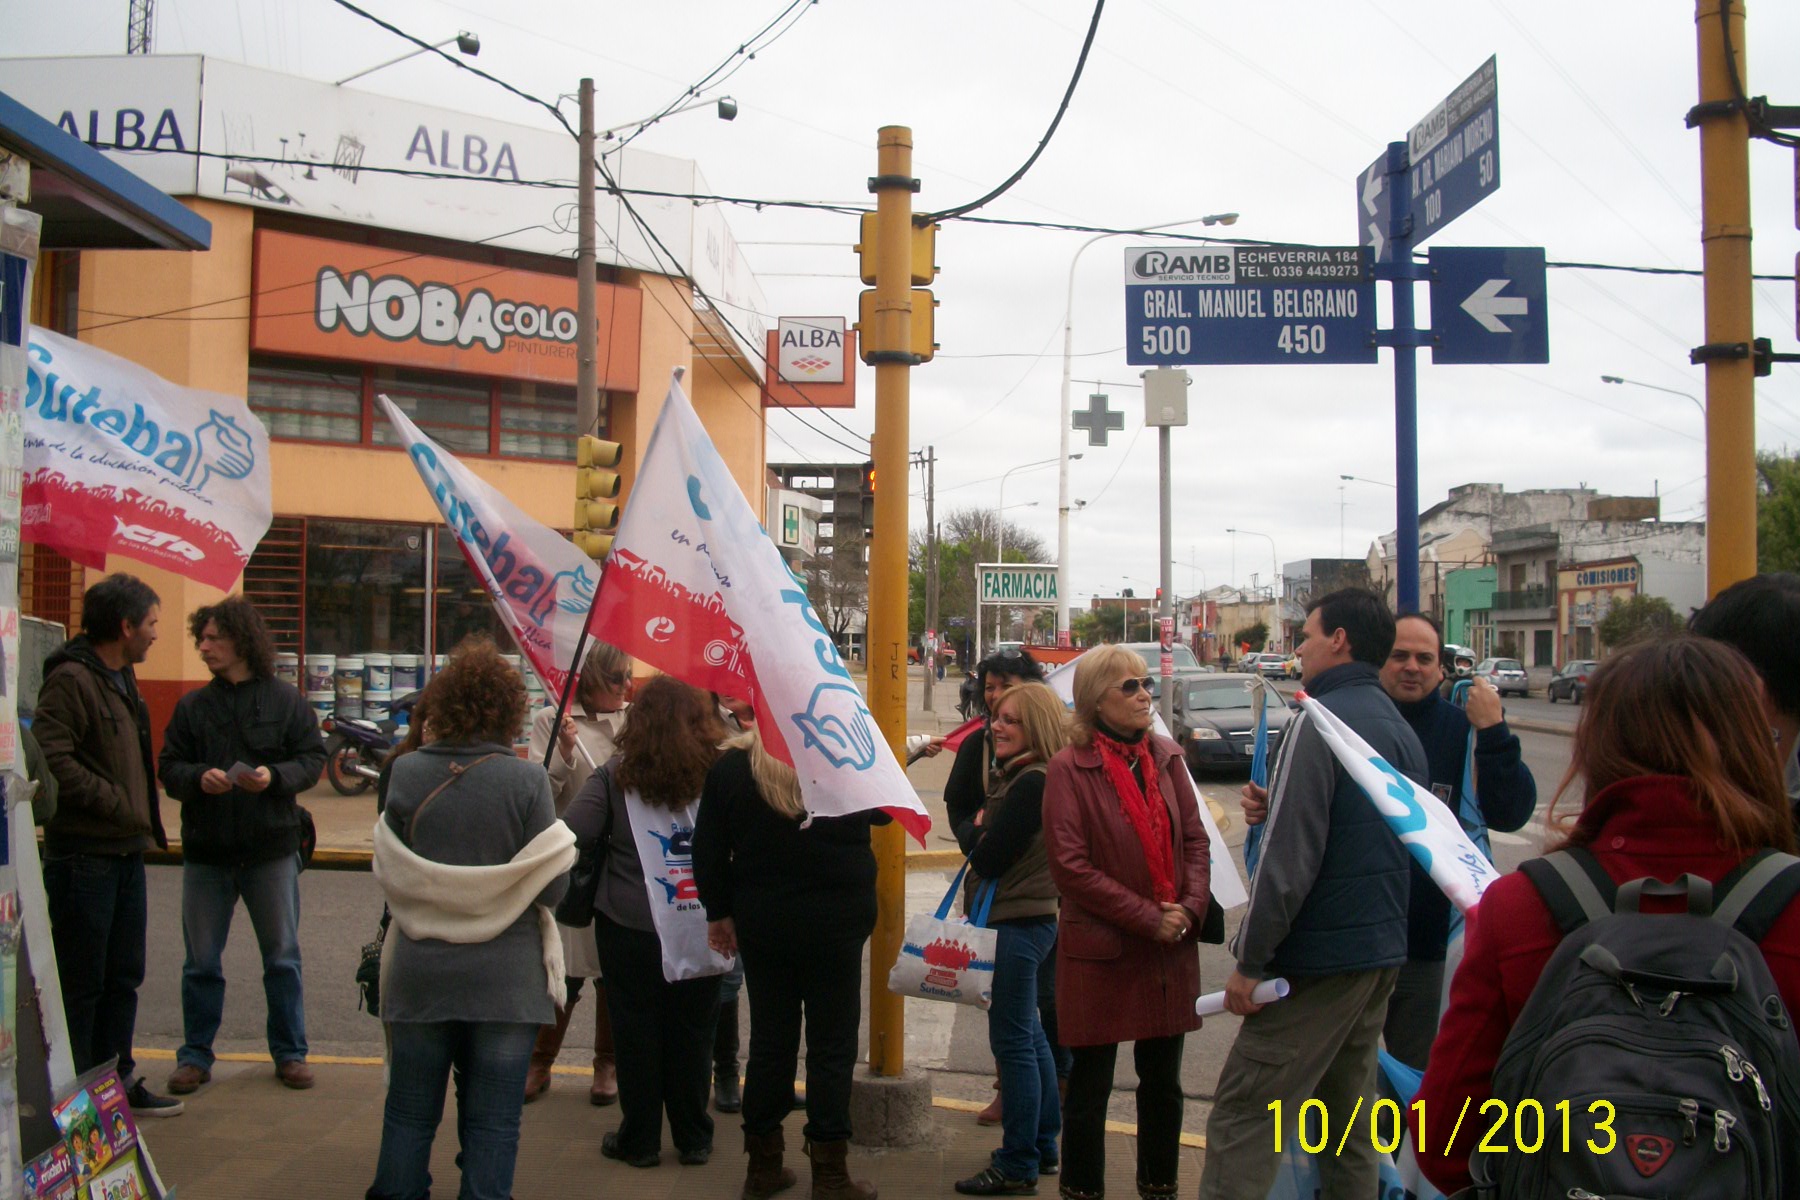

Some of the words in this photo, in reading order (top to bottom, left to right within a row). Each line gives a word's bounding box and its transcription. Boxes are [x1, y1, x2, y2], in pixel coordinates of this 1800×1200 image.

[57, 108, 186, 151] ALBA
[1464, 107, 1493, 159] MORENO
[404, 124, 520, 181] ALBA
[1479, 149, 1493, 187] 50
[1425, 188, 1441, 226] 100
[1133, 251, 1231, 280] RAMB
[1238, 252, 1332, 264] ECHEVERRIA
[1335, 251, 1359, 263] 184
[1240, 266, 1268, 277] TEL.
[1272, 266, 1303, 277] 0336
[1307, 265, 1359, 276] 4439273
[316, 266, 503, 352] NOBA
[493, 300, 598, 345] COLO
[1144, 289, 1192, 319] GRAL.
[1199, 289, 1266, 318] MANUEL
[1273, 289, 1358, 318] BELGRANO
[781, 329, 841, 348] ALBA
[1142, 325, 1191, 355] 500
[1277, 325, 1326, 354] 450
[984, 572, 1058, 599] FARMACIA
[1577, 566, 1636, 587] COMISIONES
